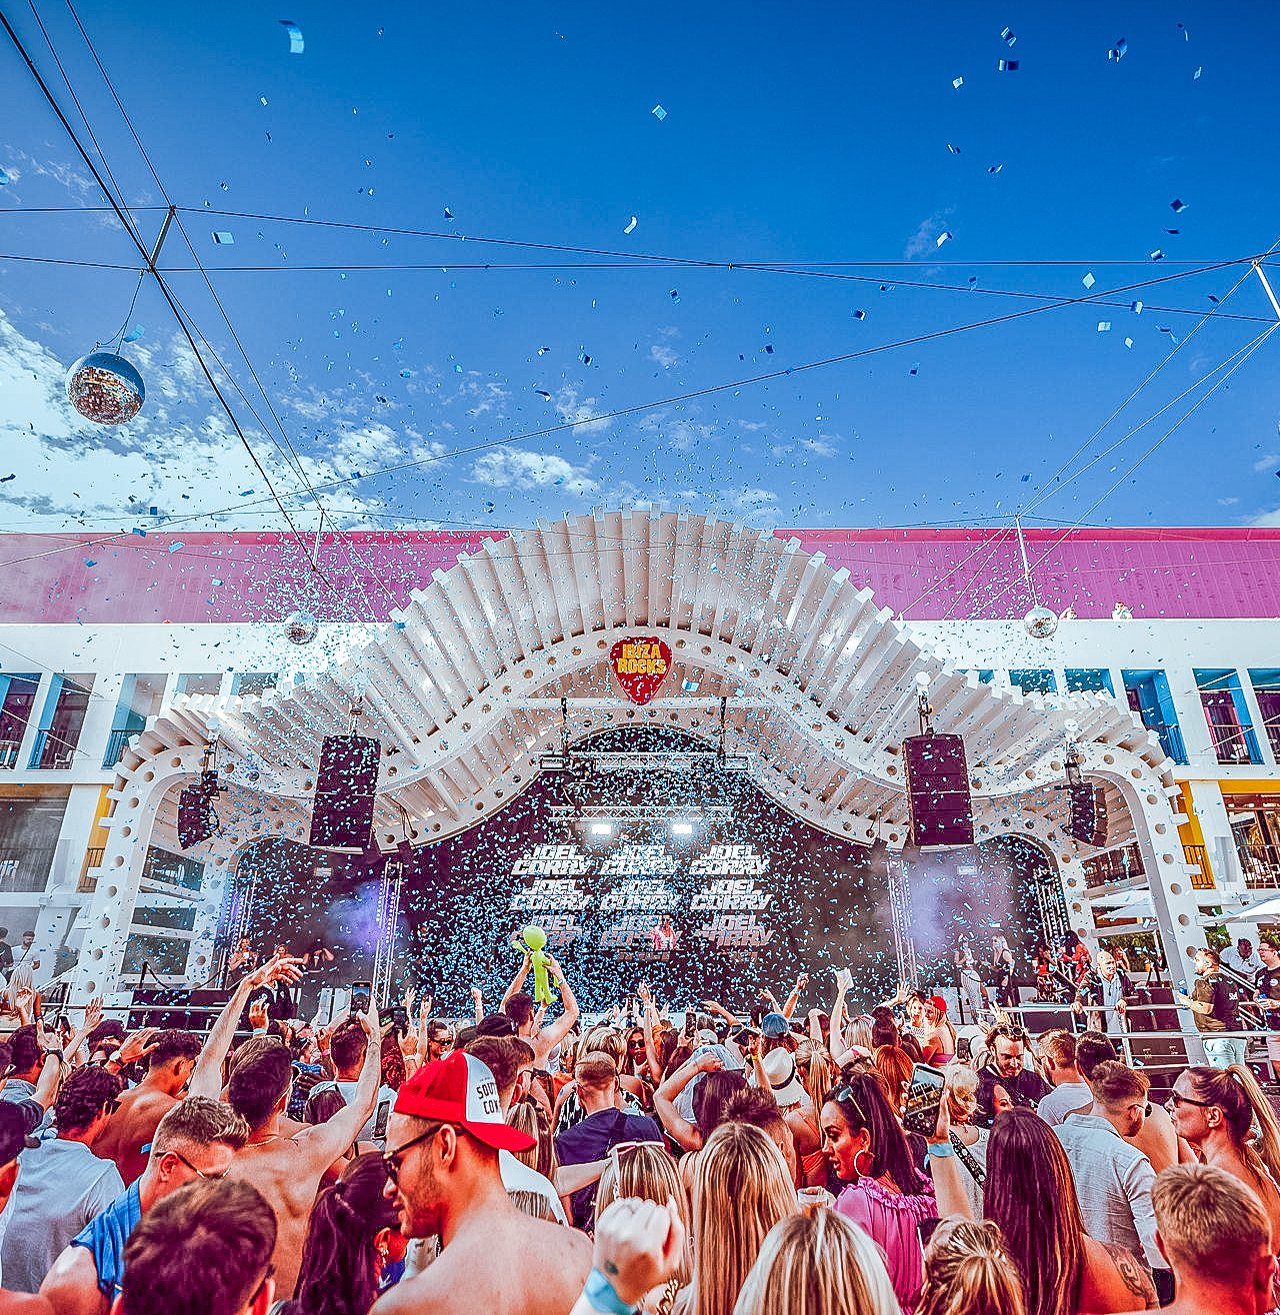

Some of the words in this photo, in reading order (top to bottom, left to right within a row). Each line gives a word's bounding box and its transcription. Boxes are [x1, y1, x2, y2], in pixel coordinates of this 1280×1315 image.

[617, 658, 666, 674] ROCKS
[523, 845, 584, 860] JOEL
[611, 845, 672, 860] JOEL
[700, 845, 761, 860] JOEL
[511, 860, 591, 875] CORRY
[689, 859, 770, 875] CORRY
[522, 880, 583, 894] JOEL
[701, 880, 762, 895] JOEL
[690, 894, 773, 910] CORRY
[702, 915, 763, 931] JOEL
